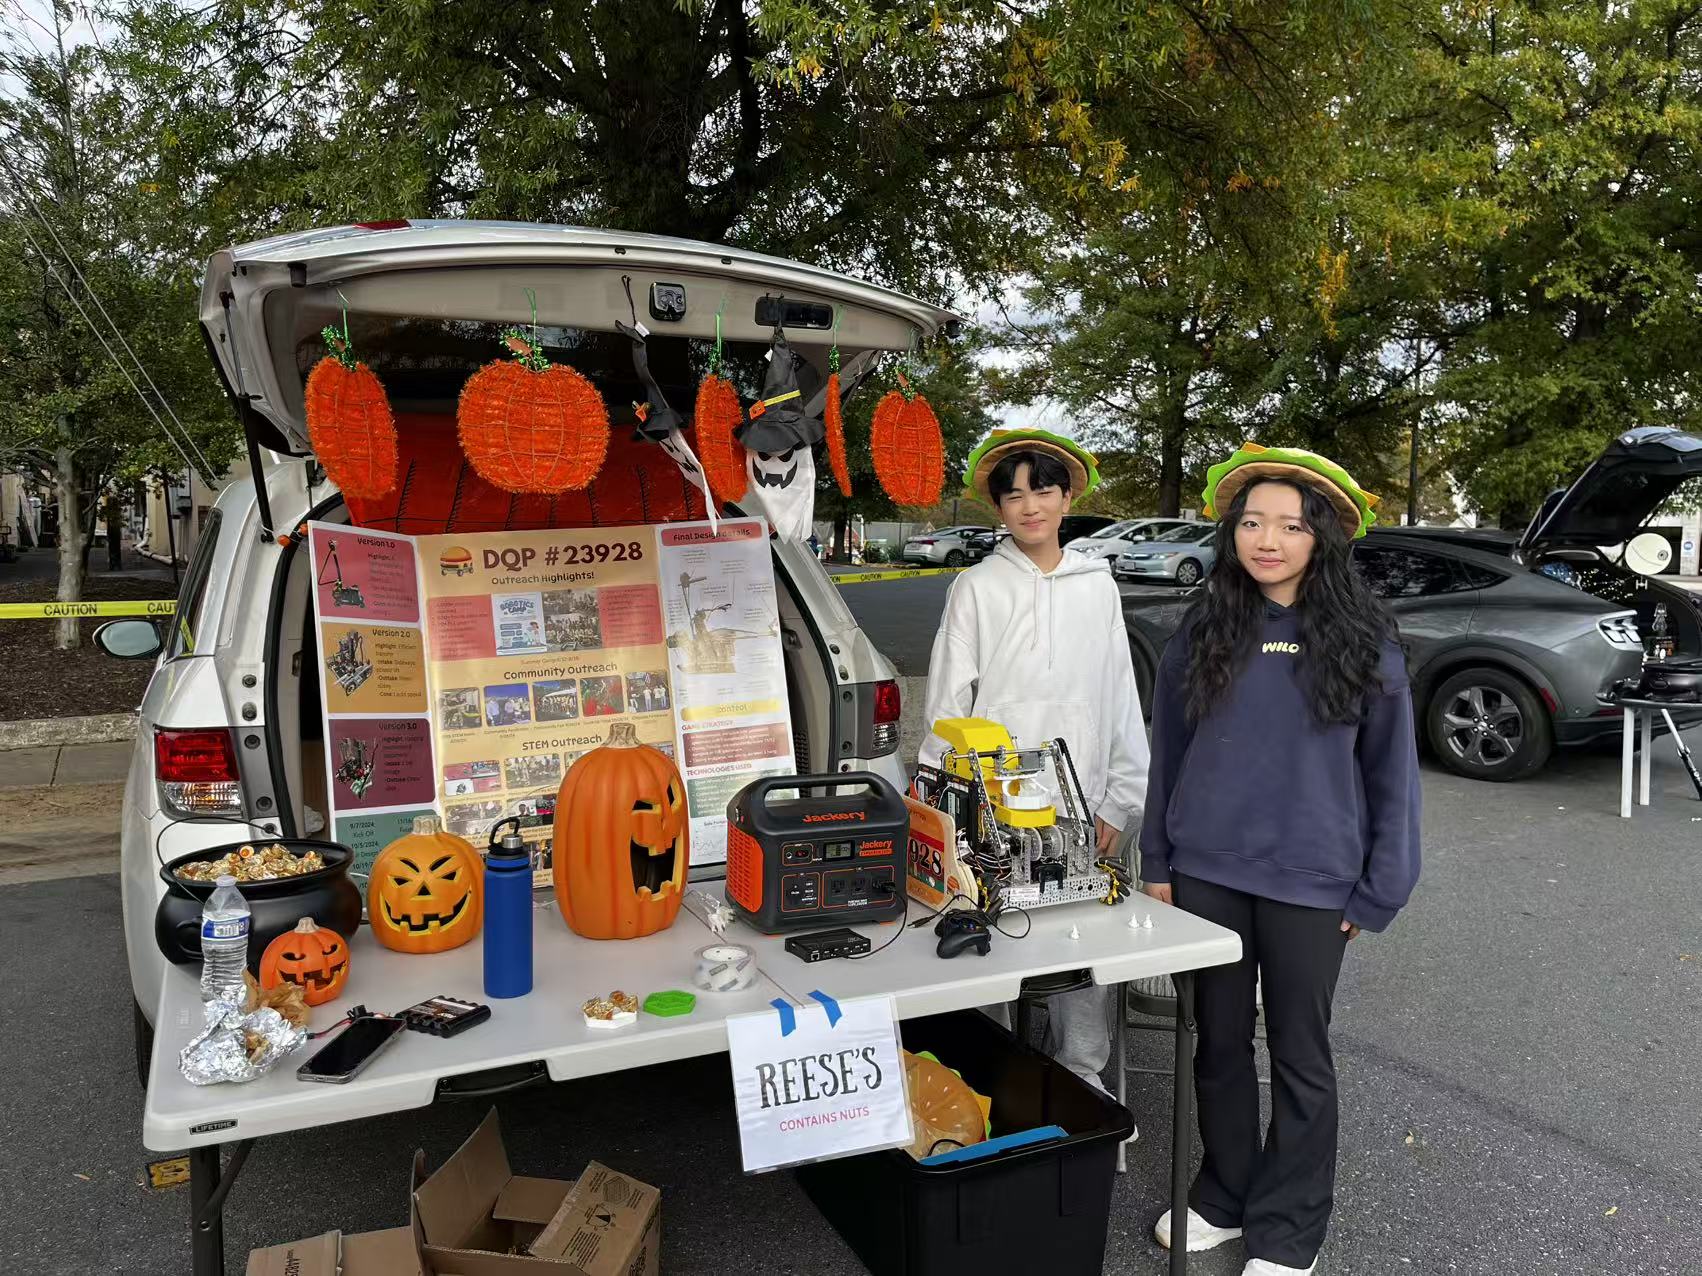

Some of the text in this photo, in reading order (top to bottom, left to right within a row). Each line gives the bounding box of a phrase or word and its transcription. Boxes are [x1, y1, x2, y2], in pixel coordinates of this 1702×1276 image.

[673, 532, 693, 541] Final
[694, 531, 720, 541] Design
[357, 538, 396, 550] Version 1.0
[483, 541, 643, 572] DQP #23928
[491, 571, 595, 586] Outreach Highlights!
[860, 573, 882, 582] CAUTION
[901, 570, 920, 578] CAUTION
[44, 603, 97, 616] CAUTION
[146, 602, 177, 615] CAUT
[500, 599, 534, 611] ROBOTICS
[372, 629, 411, 639] Version 2.0
[504, 662, 618, 681] Community Outreach
[406, 722, 417, 730] 3.0
[521, 734, 602, 751] STEM Outreach
[687, 765, 734, 777] TECHNOLOGIES
[802, 811, 866, 823] Jackery
[860, 840, 893, 850] Jackery
[910, 838, 942, 876] 928
[755, 1046, 882, 1110] REESE'S
[779, 1106, 870, 1132] CONTAINS NUTS
[195, 1121, 232, 1132] LIFETIME
